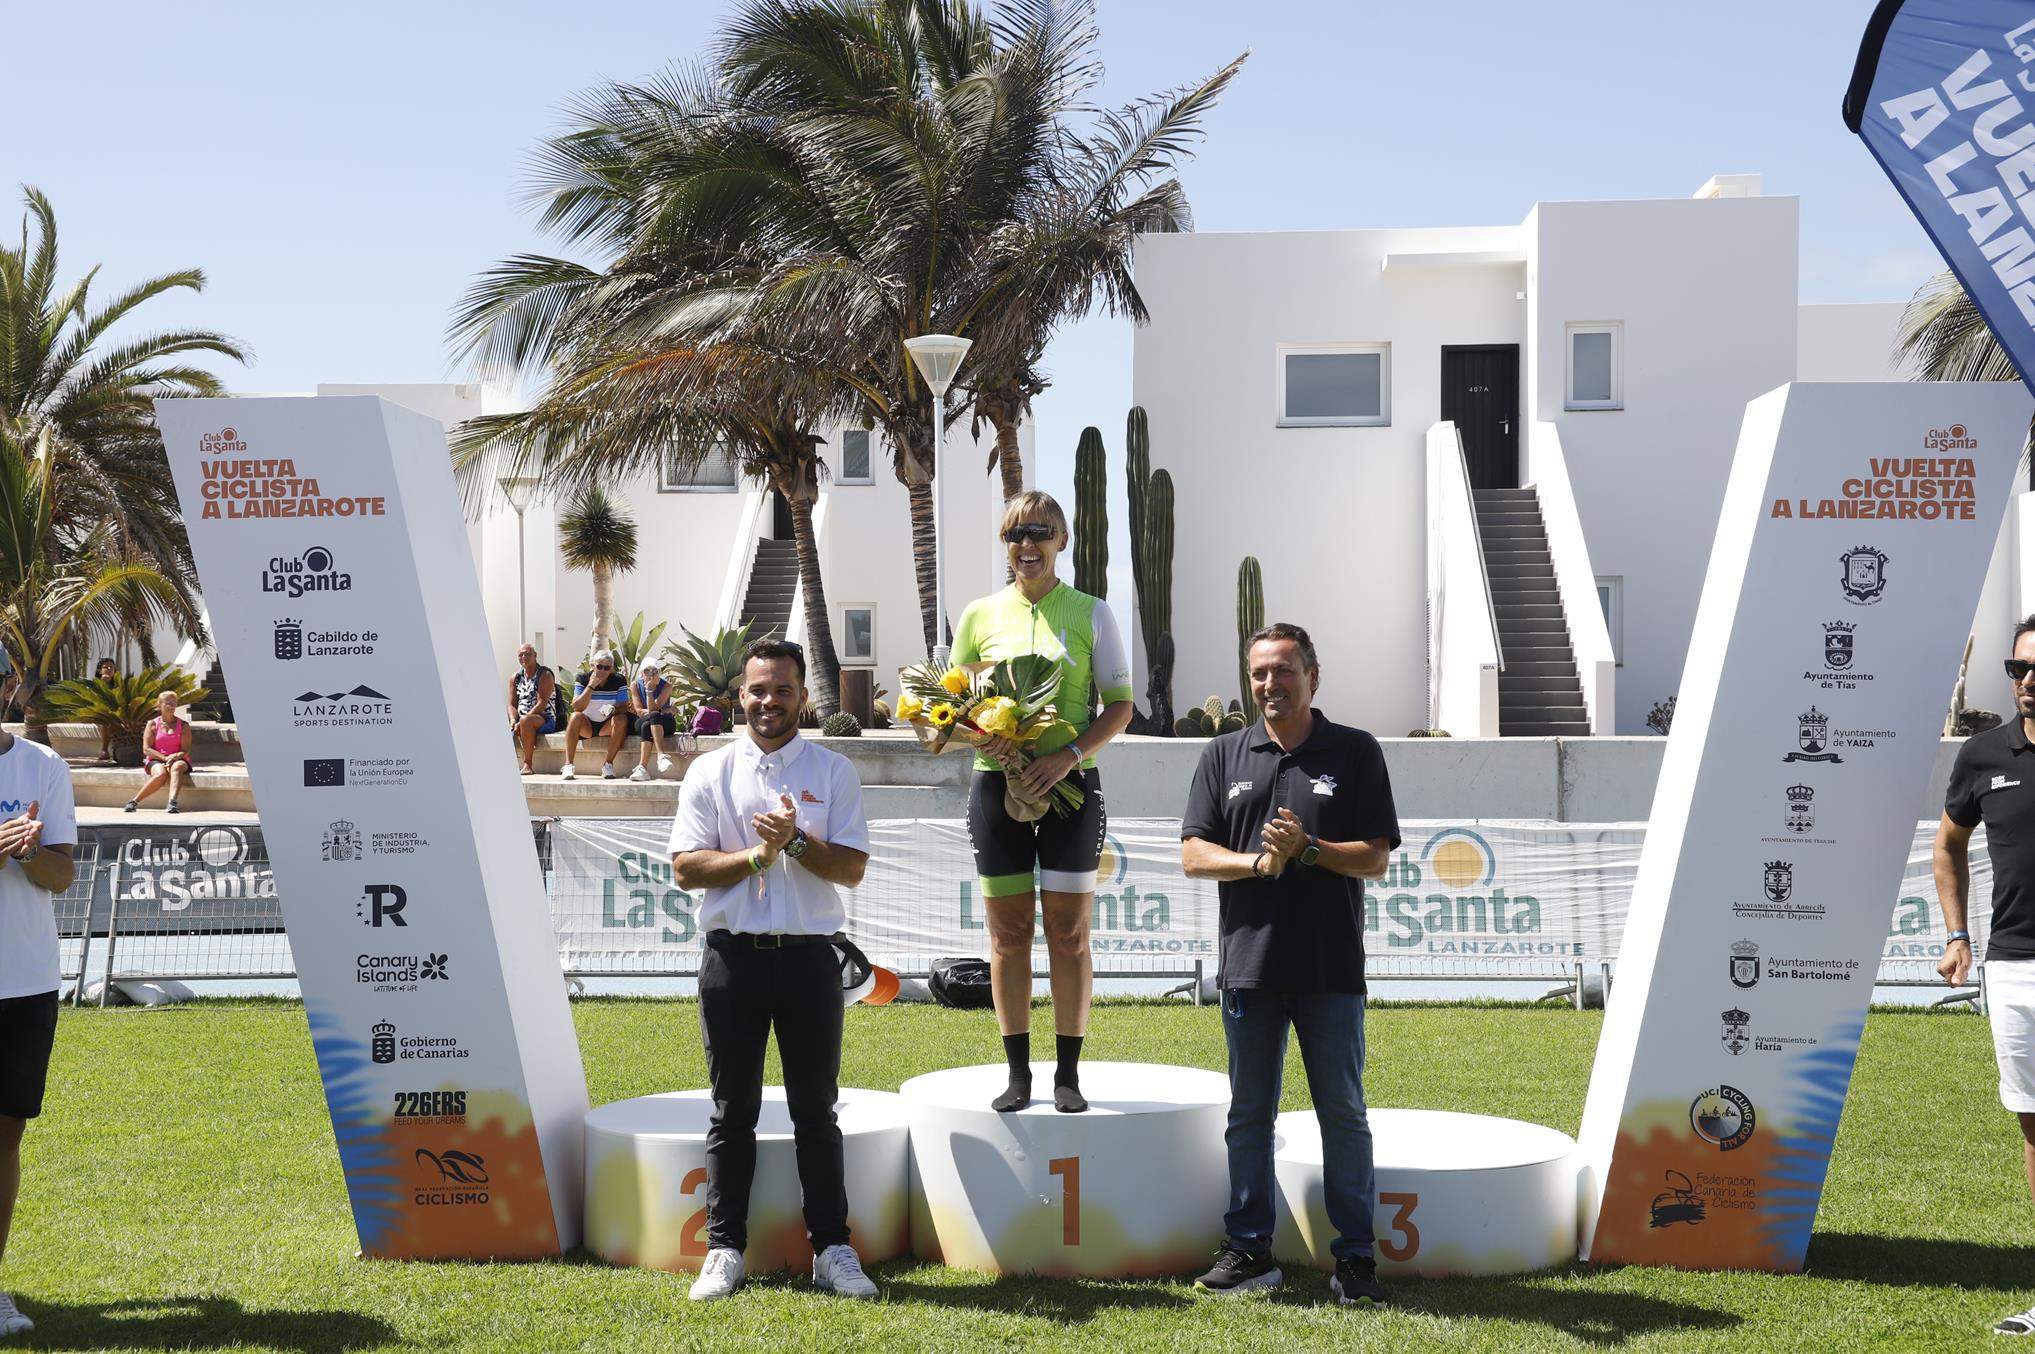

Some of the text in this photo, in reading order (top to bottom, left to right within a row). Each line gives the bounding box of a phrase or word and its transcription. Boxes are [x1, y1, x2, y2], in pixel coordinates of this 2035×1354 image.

[1880, 87, 1951, 150] A
[203, 433, 221, 442] Club
[1929, 429, 1949, 439] Club
[201, 459, 296, 479] VUELTA
[1869, 458, 1976, 478] VUELTA
[201, 479, 320, 499] CICLISTA
[1842, 479, 1976, 499] CICLISTA
[202, 497, 385, 519] A LANZAROTE
[1771, 500, 1976, 520] A LANZAROTE
[269, 557, 303, 574] Club
[307, 631, 378, 643] Cabildo de
[307, 644, 374, 656] Lanzarote
[1803, 672, 1874, 682] Ayuntamiento
[1821, 682, 1833, 690] de
[294, 704, 392, 716] LANZAROTE
[294, 717, 393, 728] SPORTS DESTINATION
[1833, 729, 1896, 739] Ayuntamiento
[1833, 739, 1874, 748] de YAIZA
[350, 758, 410, 767] Financiado por
[358, 768, 381, 776] Unión
[383, 768, 414, 778] Europea
[124, 839, 190, 866] Club
[618, 852, 671, 885] Clu
[1428, 941, 1586, 956] LANZAROTE
[357, 954, 418, 970] Canary
[1768, 957, 1859, 969] Ayuntamiento de
[357, 968, 418, 982] Islands
[1768, 969, 1851, 981] San Bartolomé
[400, 1036, 457, 1047] Gobierno
[1755, 1036, 1817, 1045] Ayuntamiento de
[400, 1047, 469, 1059] de Canarias
[394, 1090, 466, 1117] 226ERS
[1701, 1088, 1719, 1099] UCI
[1722, 1088, 1753, 1121] CYCLING
[394, 1115, 466, 1126] FEED YOUR DREAMS
[1743, 1186, 1756, 1198] de
[415, 1193, 489, 1205] CICLISMO
[1049, 1156, 1080, 1246] 1
[1712, 1199, 1756, 1210] Ciclismo
[1379, 1192, 1420, 1262] 3
